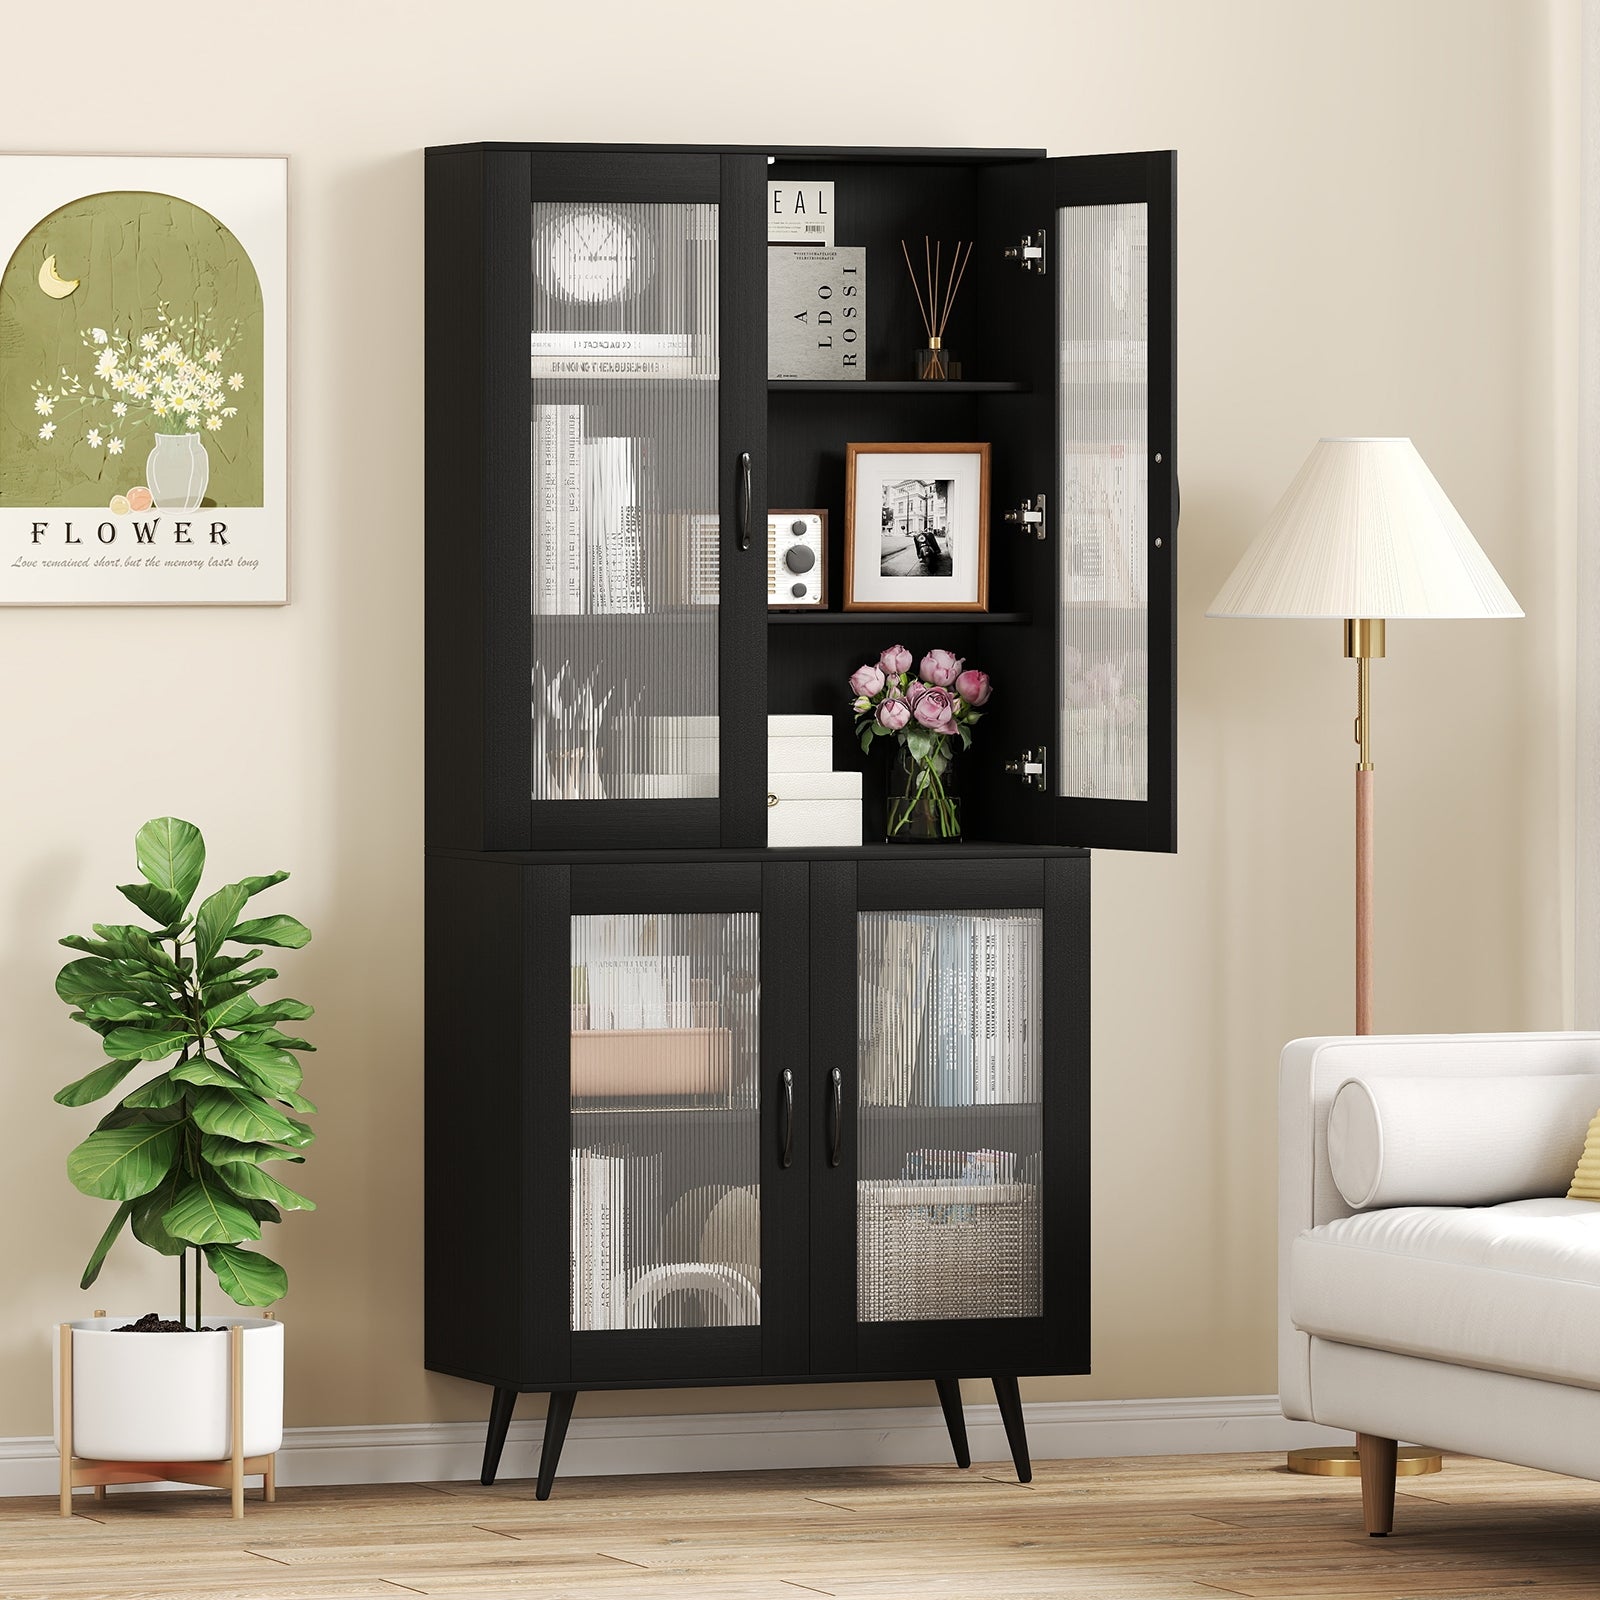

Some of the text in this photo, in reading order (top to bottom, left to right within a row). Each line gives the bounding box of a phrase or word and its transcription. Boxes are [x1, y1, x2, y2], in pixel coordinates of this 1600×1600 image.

[793, 310, 808, 325] A
[817, 285, 833, 349] LDO
[842, 266, 858, 368] ROSSI
[31, 517, 230, 545] FLOWER
[11, 555, 38, 568] Love
[41, 558, 91, 568] remained
[144, 555, 160, 567] the
[164, 559, 205, 570] memory
[207, 556, 233, 567] lasts
[237, 556, 259, 570] long
